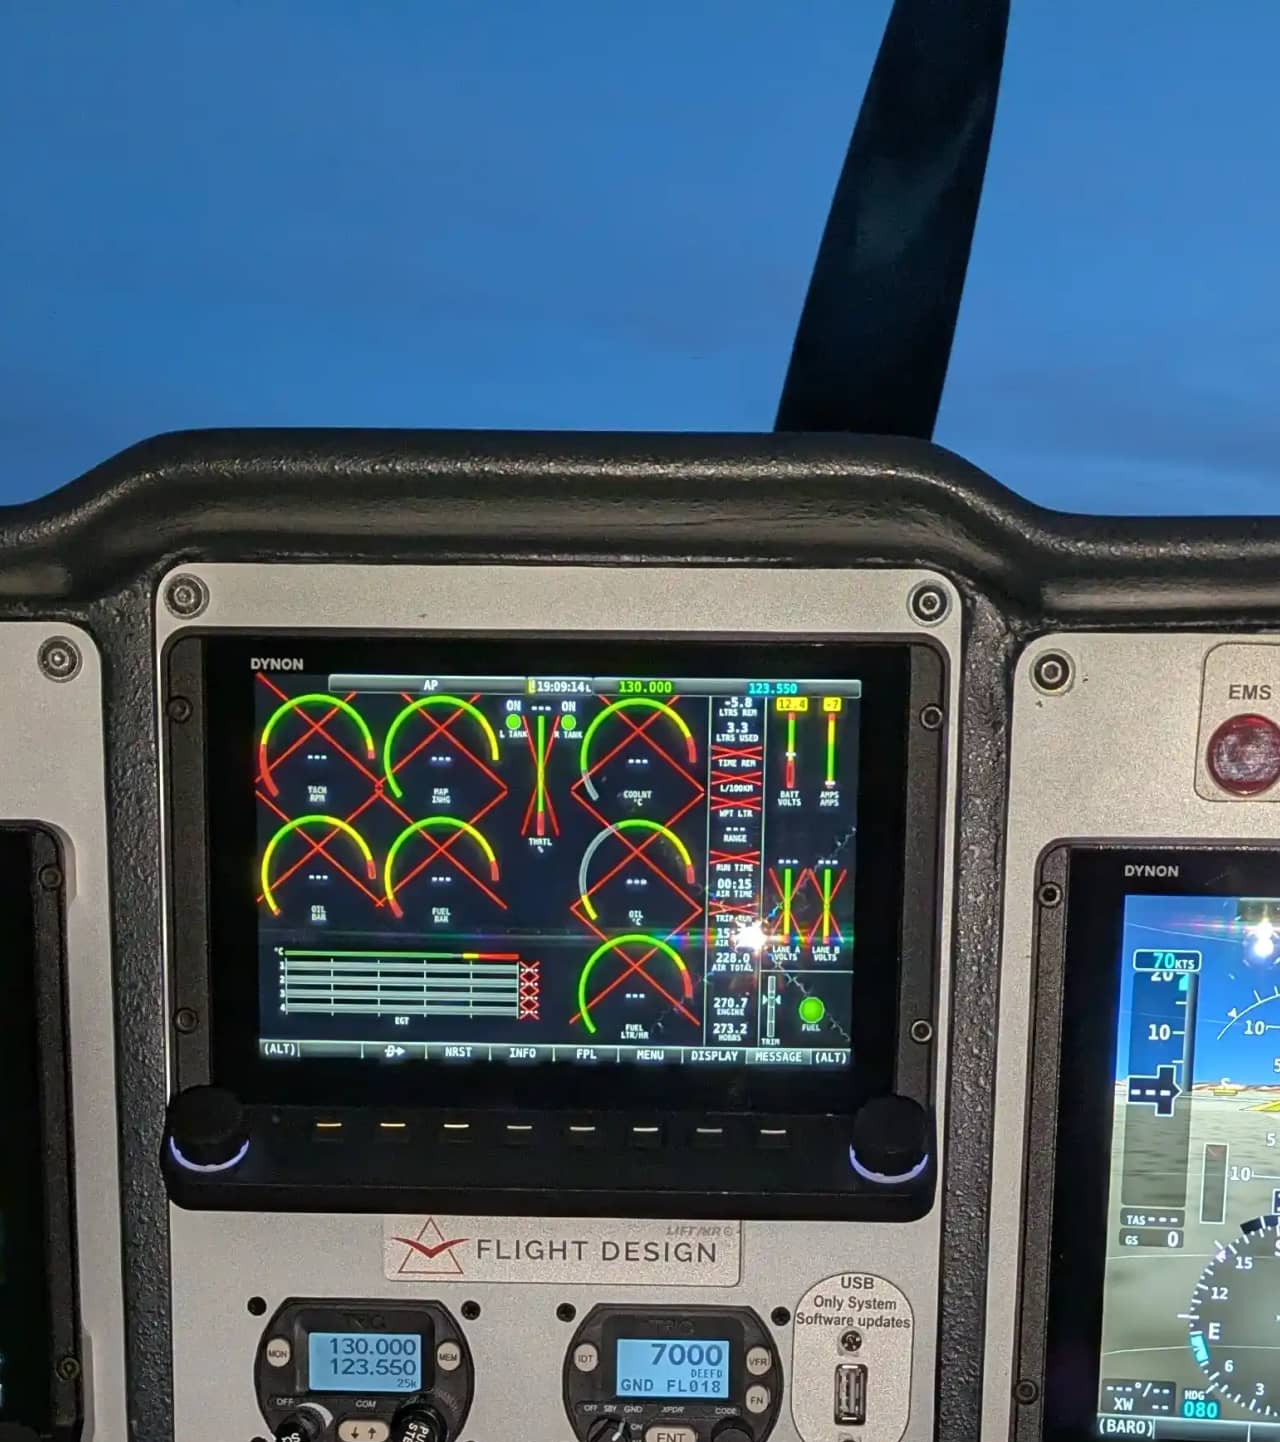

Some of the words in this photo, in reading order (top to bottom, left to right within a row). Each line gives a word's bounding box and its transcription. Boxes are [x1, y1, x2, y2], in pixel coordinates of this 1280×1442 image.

[250, 658, 304, 670] DYNON
[620, 681, 672, 693] 130.000
[1229, 684, 1271, 700] EMS
[755, 1051, 802, 1063] MESSAGE
[477, 1239, 588, 1262] FLIGHT
[601, 1241, 717, 1262] DESIGN
[841, 1276, 874, 1290] USB
[814, 1295, 844, 1311] Only
[848, 1296, 896, 1312] System
[796, 1312, 854, 1326] Software
[858, 1316, 911, 1329] updates
[329, 1338, 416, 1356] 130.000
[651, 1343, 723, 1366] 7000
[330, 1358, 416, 1376] 123.550
[691, 1369, 723, 1378] DEEFD
[621, 1379, 654, 1392] GND
[667, 1381, 721, 1393] FL018
